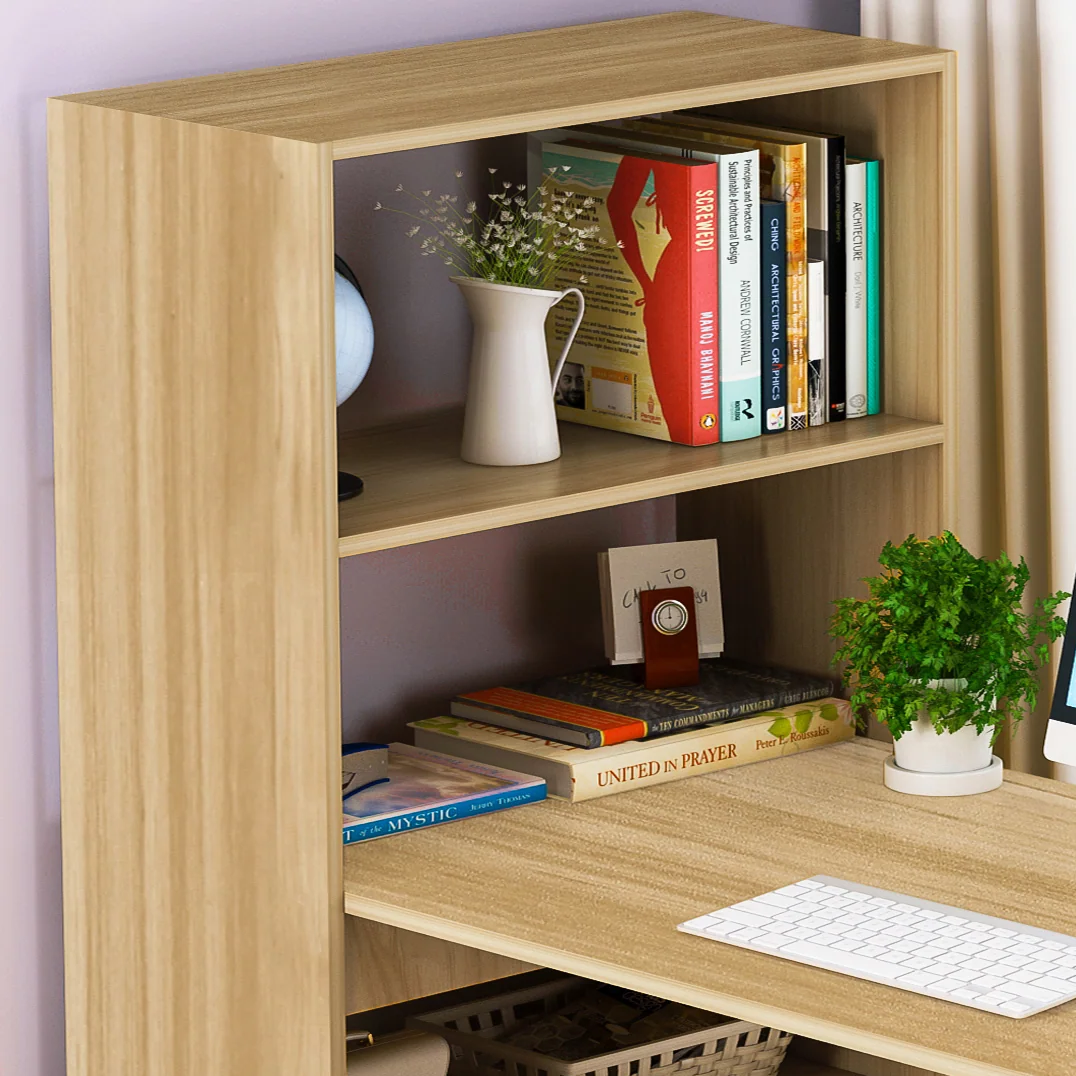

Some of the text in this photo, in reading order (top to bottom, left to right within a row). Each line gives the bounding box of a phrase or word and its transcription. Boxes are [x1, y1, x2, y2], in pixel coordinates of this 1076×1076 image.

[744, 159, 752, 189] Principles
[727, 161, 739, 265] Sustainable Architectural Design
[744, 190, 752, 203] and
[695, 189, 715, 252] SCREWED!
[744, 203, 752, 233] Practices
[770, 218, 779, 251] CHING
[852, 202, 863, 261] ARCHITECTURE
[740, 280, 752, 366] ANDREW CORNWALL
[771, 264, 784, 401] ARCHITECTURAL GRAPHICS
[700, 311, 714, 400] MANOJ BHAVNANI
[673, 708, 730, 729] COMMANDMENTS
[739, 698, 775, 713] MANAGERS
[755, 726, 830, 751] Peter Roussakis
[597, 744, 738, 787] UNITED IN PRAYER
[359, 806, 458, 837] of the MYSTIC
